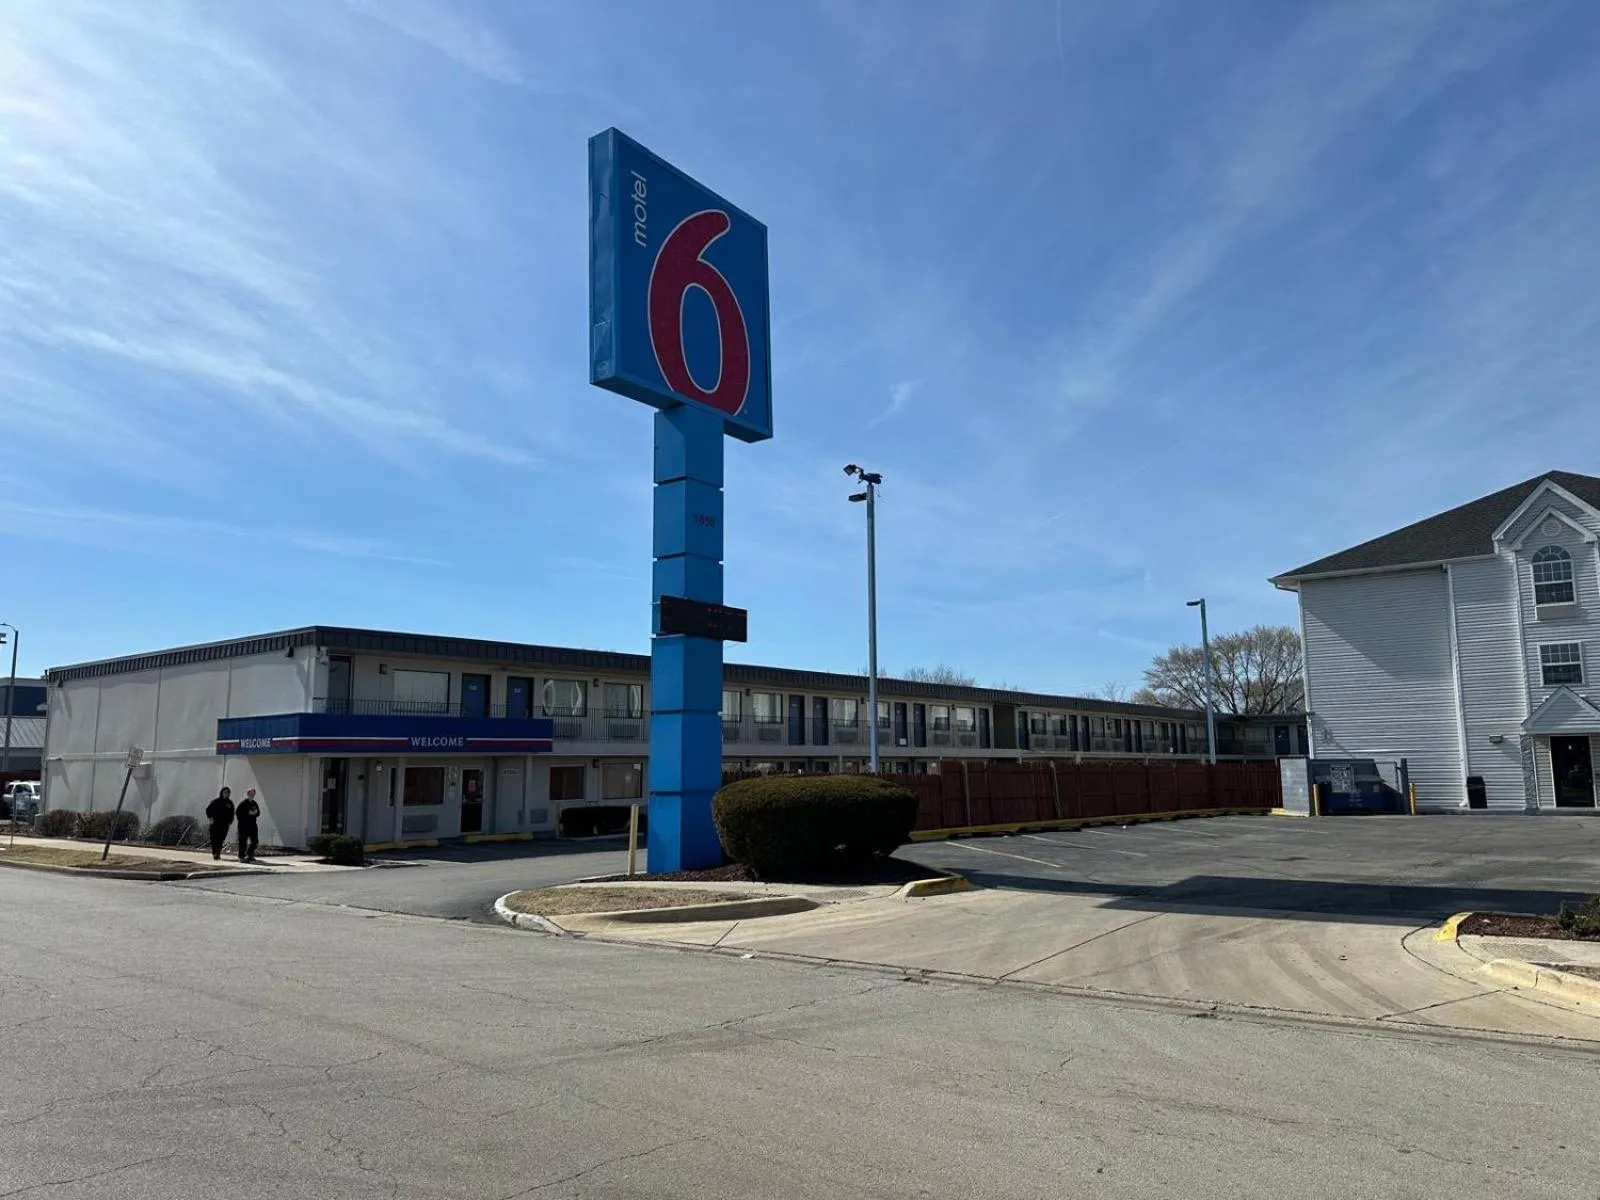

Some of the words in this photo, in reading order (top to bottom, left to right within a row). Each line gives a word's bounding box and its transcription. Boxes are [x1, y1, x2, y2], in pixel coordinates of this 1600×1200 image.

[631, 170, 648, 248] motel
[648, 208, 751, 416] 6
[240, 737, 272, 748] WELCOME
[410, 736, 465, 747] WELCOME
